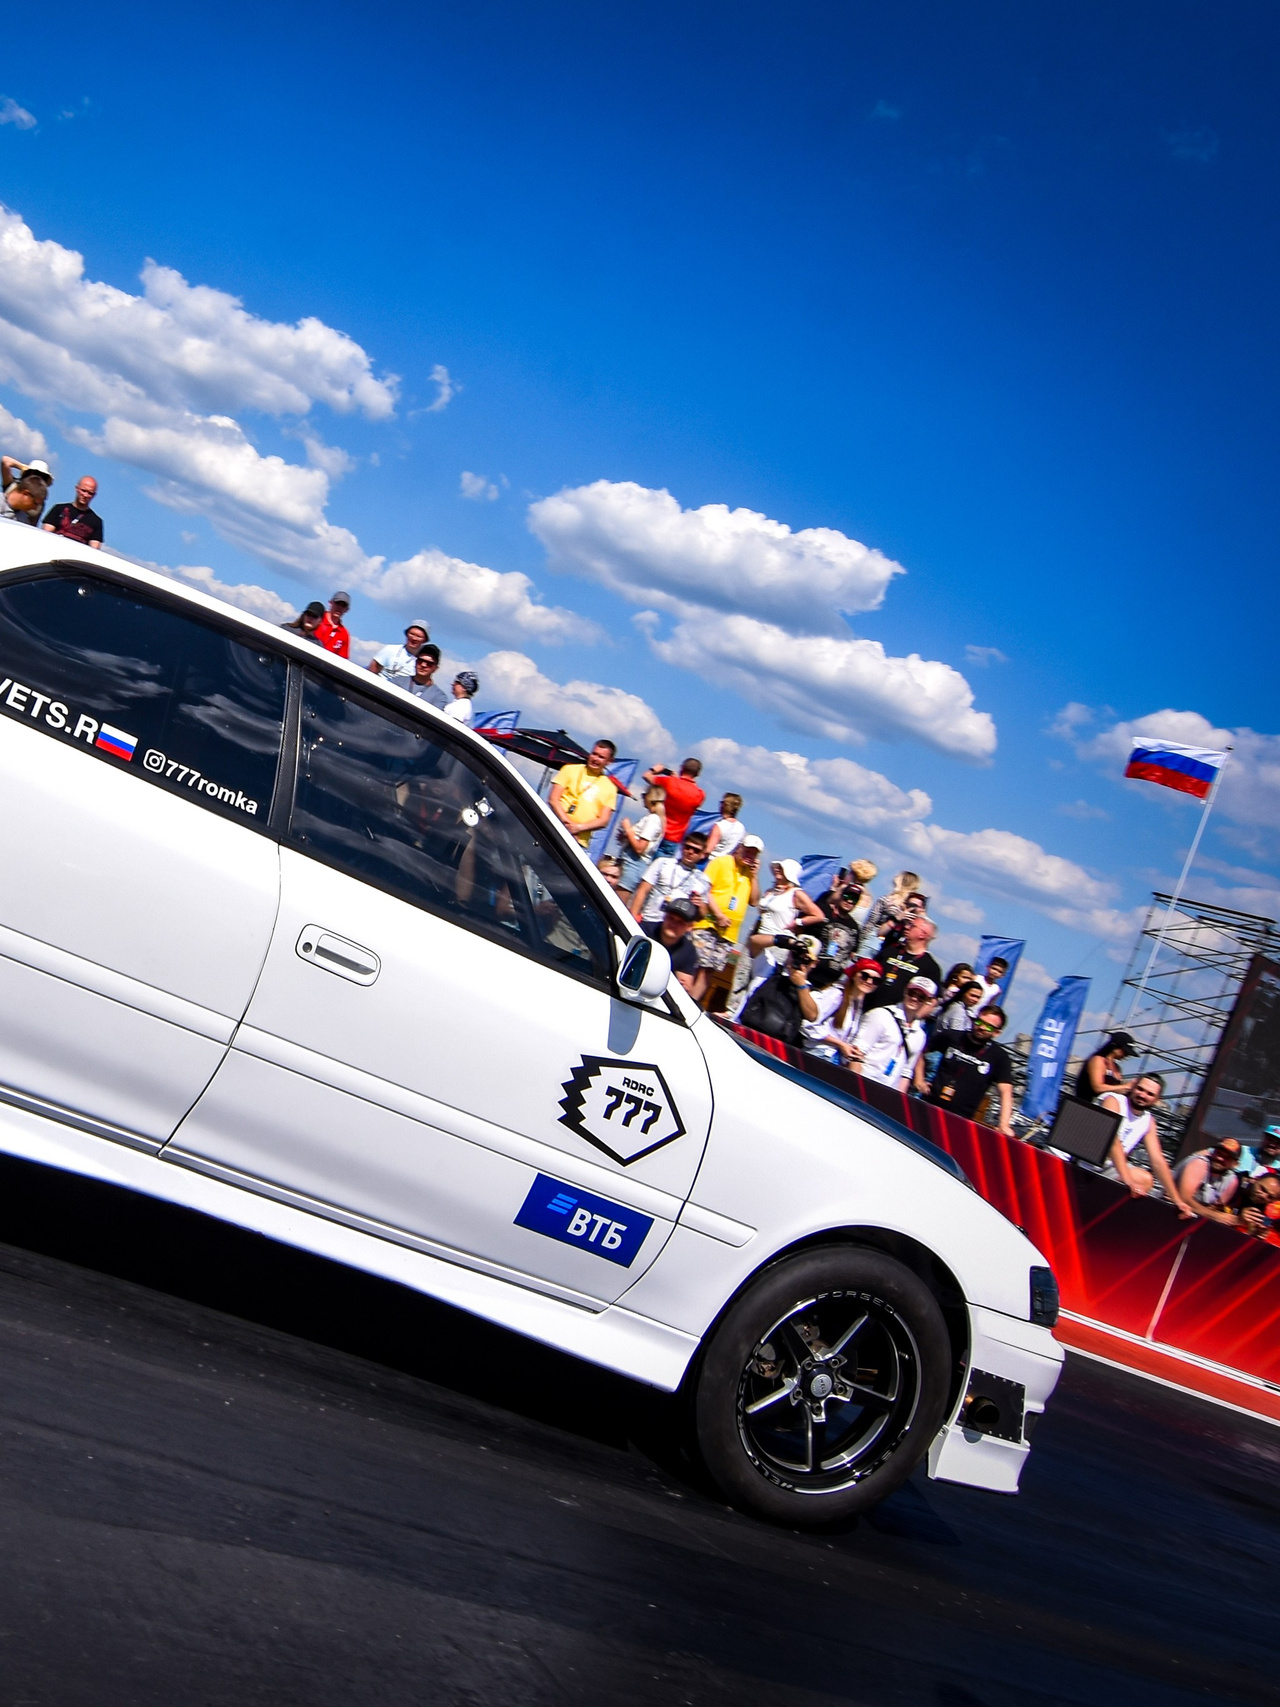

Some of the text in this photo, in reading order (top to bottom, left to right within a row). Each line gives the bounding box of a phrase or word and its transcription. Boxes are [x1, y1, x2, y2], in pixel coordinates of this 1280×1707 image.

[165, 760, 258, 815] 777romka
[622, 1076, 655, 1098] RDRC
[603, 1085, 662, 1135] 777
[567, 1207, 628, 1250] ВТБ
[817, 1290, 895, 1315] FORGED
